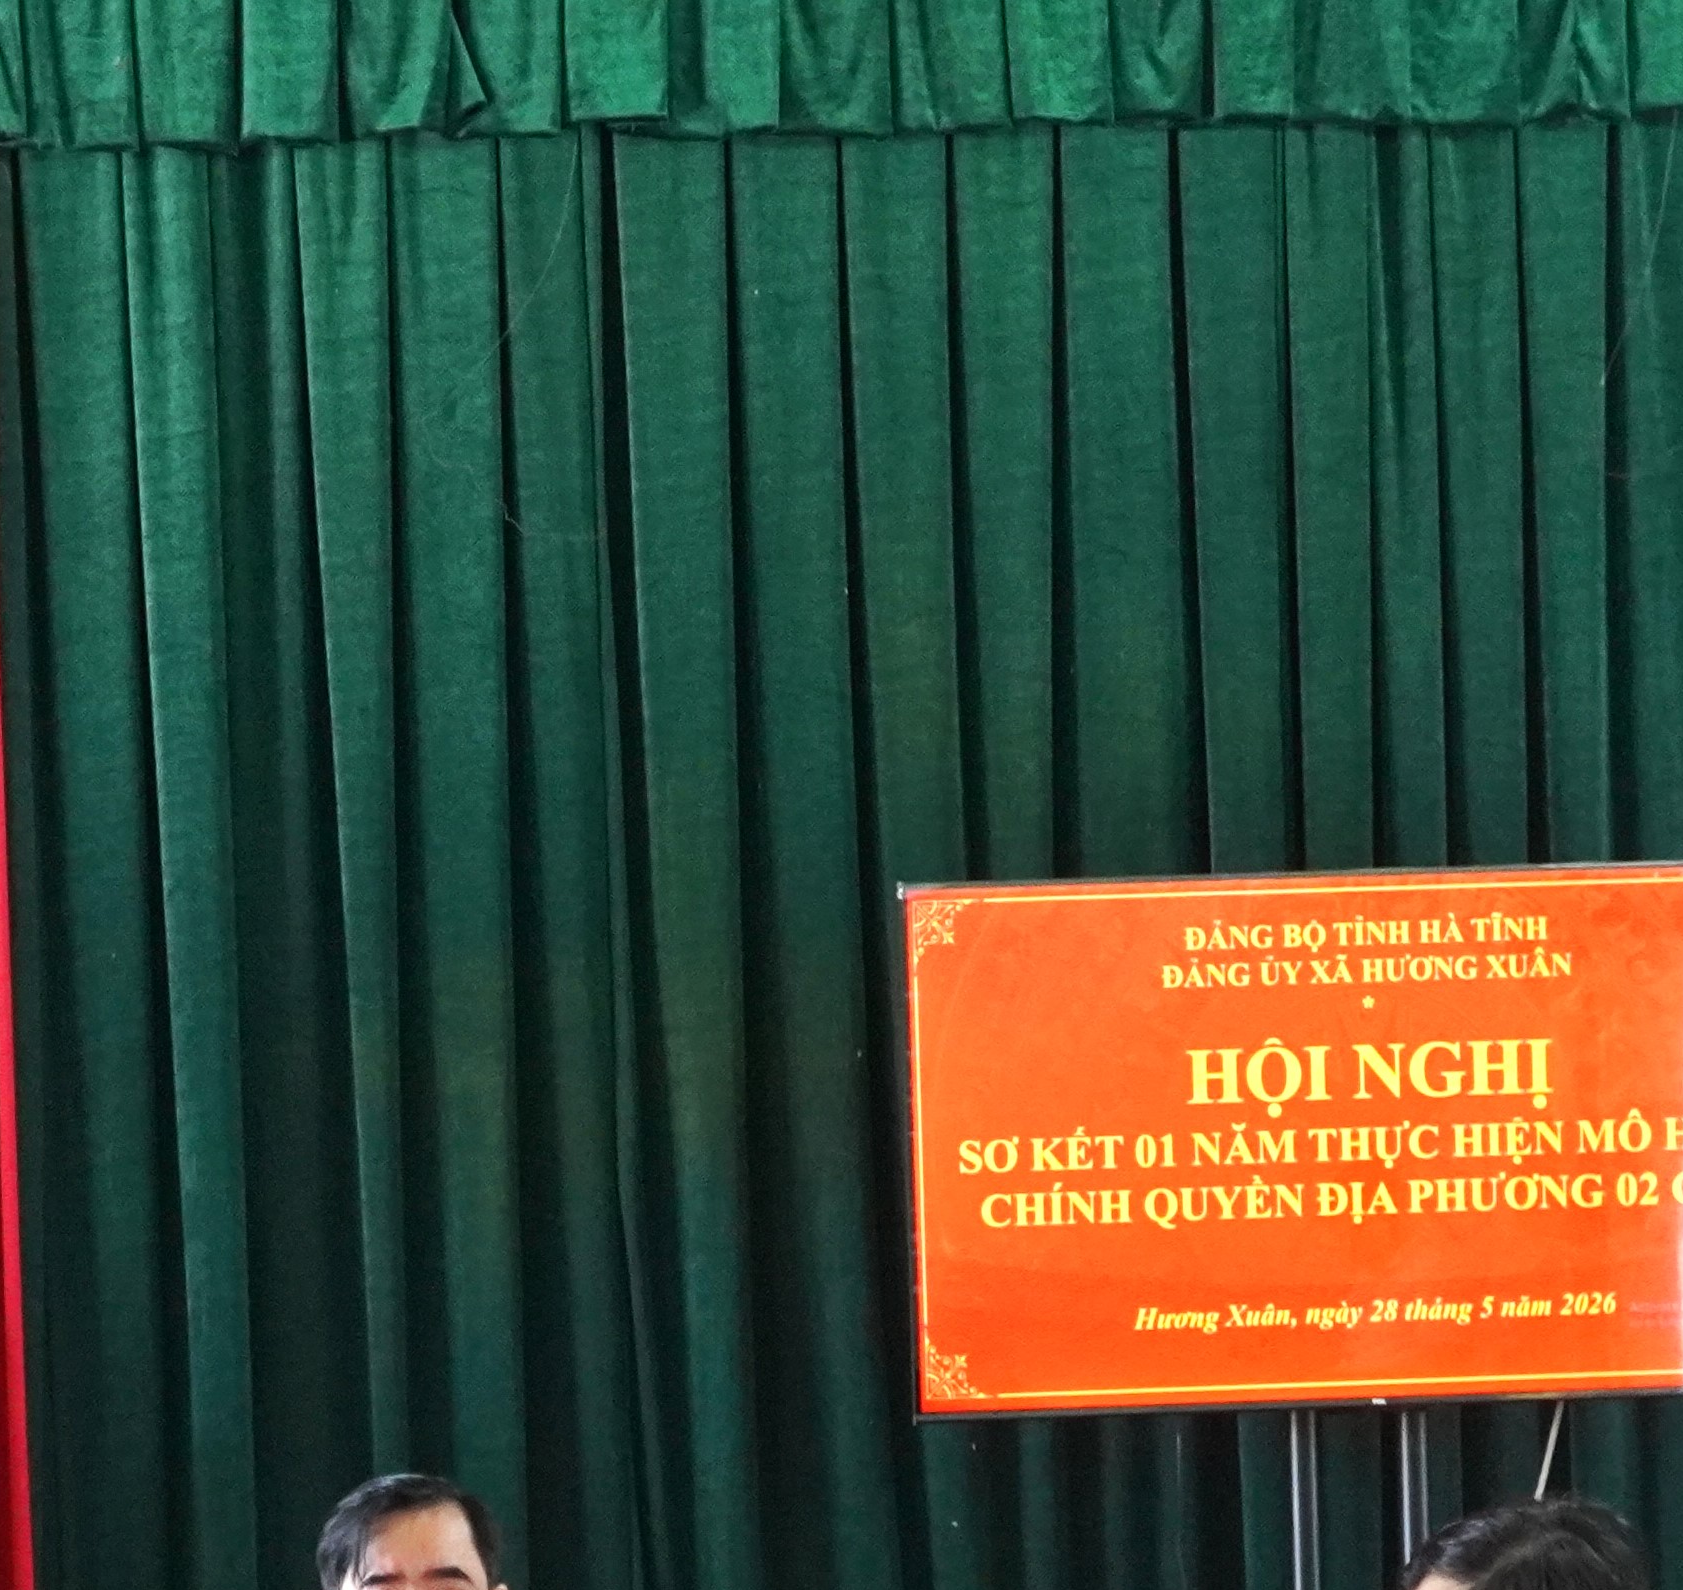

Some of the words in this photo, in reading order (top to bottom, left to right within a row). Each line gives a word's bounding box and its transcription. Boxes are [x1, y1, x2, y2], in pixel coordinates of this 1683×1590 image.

[1184, 920, 1273, 951] ĐẢNG
[1282, 920, 1326, 952] BỘ
[1333, 915, 1410, 945] TỈNH
[1419, 913, 1464, 943] HÀ
[1470, 912, 1548, 941] TĨNH
[1162, 957, 1250, 988] ĐẢNG
[1260, 956, 1302, 986] ỦY
[1310, 954, 1353, 984] XÃ
[1362, 954, 1477, 983] HƯƠNG
[1486, 947, 1572, 978] XUÂN
[1186, 1037, 1332, 1118] HỘI
[1352, 1038, 1554, 1109] NGHỊ
[958, 1137, 1019, 1174] SƠ
[1030, 1126, 1124, 1172] KẾT
[1135, 1134, 1177, 1168] 01
[1192, 1122, 1297, 1166] NĂM
[1307, 1120, 1440, 1168] THỰC
[1451, 1117, 1565, 1165] HIỆN
[1578, 1108, 1653, 1154] MÔ
[980, 1182, 1133, 1228] CHÍNH
[1144, 1175, 1303, 1230] QUYỀN
[1317, 1180, 1398, 1225] ĐỊA
[1407, 1172, 1605, 1214] PHƯƠNG
[1617, 1172, 1660, 1207] 02
[1133, 1307, 1219, 1333] Hương
[1225, 1303, 1298, 1328] Xuân,
[1305, 1301, 1363, 1329] ngày
[1369, 1299, 1399, 1323] 28
[1404, 1298, 1473, 1323] tháng
[1480, 1295, 1495, 1318] 5
[1500, 1295, 1553, 1317] năm
[1560, 1292, 1617, 1316] 2026
